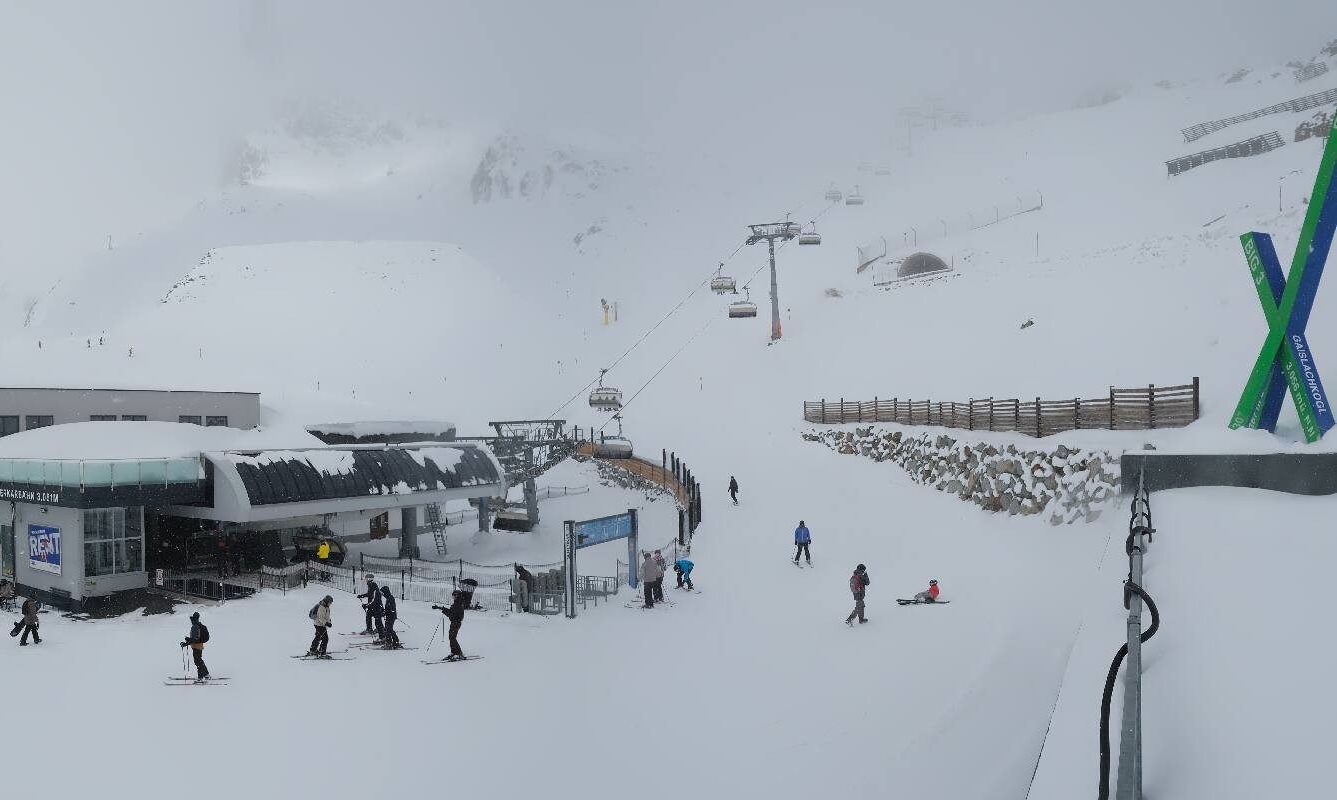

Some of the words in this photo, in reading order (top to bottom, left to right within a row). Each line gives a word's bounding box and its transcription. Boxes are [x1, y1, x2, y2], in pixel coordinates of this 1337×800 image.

[1244, 239, 1260, 271] BIG
[1254, 271, 1265, 285] 3
[1292, 335, 1327, 416] GAISLACHKOGL
